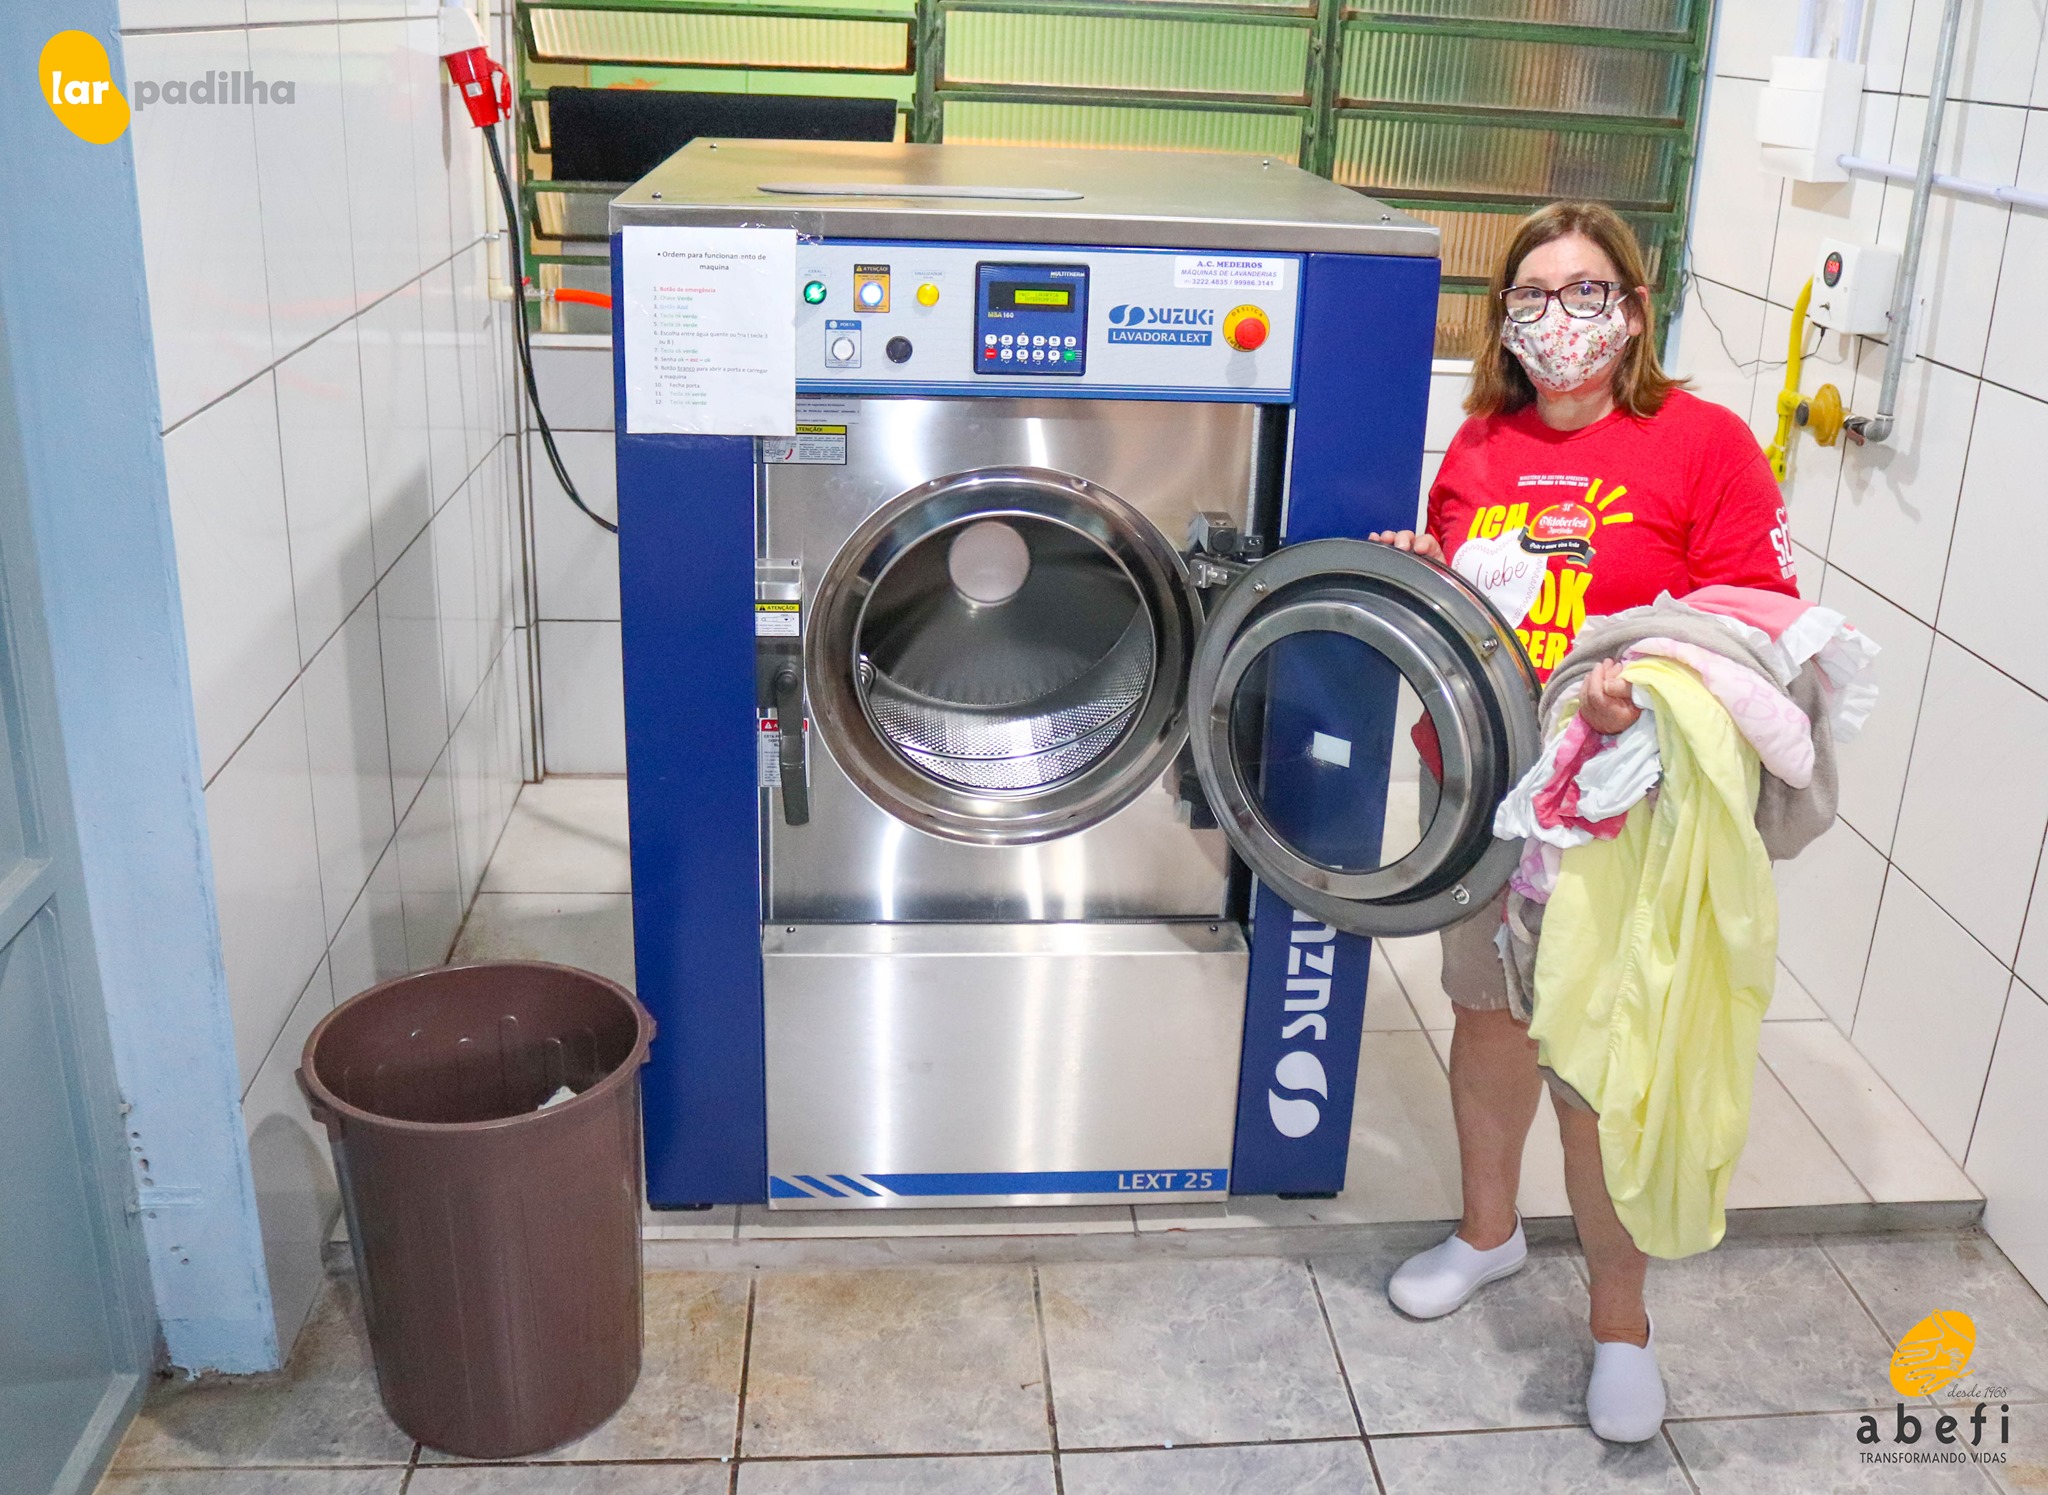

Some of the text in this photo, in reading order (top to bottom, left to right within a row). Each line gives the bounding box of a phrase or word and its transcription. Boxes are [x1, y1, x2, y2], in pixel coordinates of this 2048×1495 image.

[1112, 331, 1209, 343] LAVADORA LEXT
[1467, 502, 1529, 541] ICH
[1539, 516, 1588, 528] Oktoberfest
[1528, 569, 1593, 635] OK
[1118, 1172, 1213, 1190] LEXT 25
